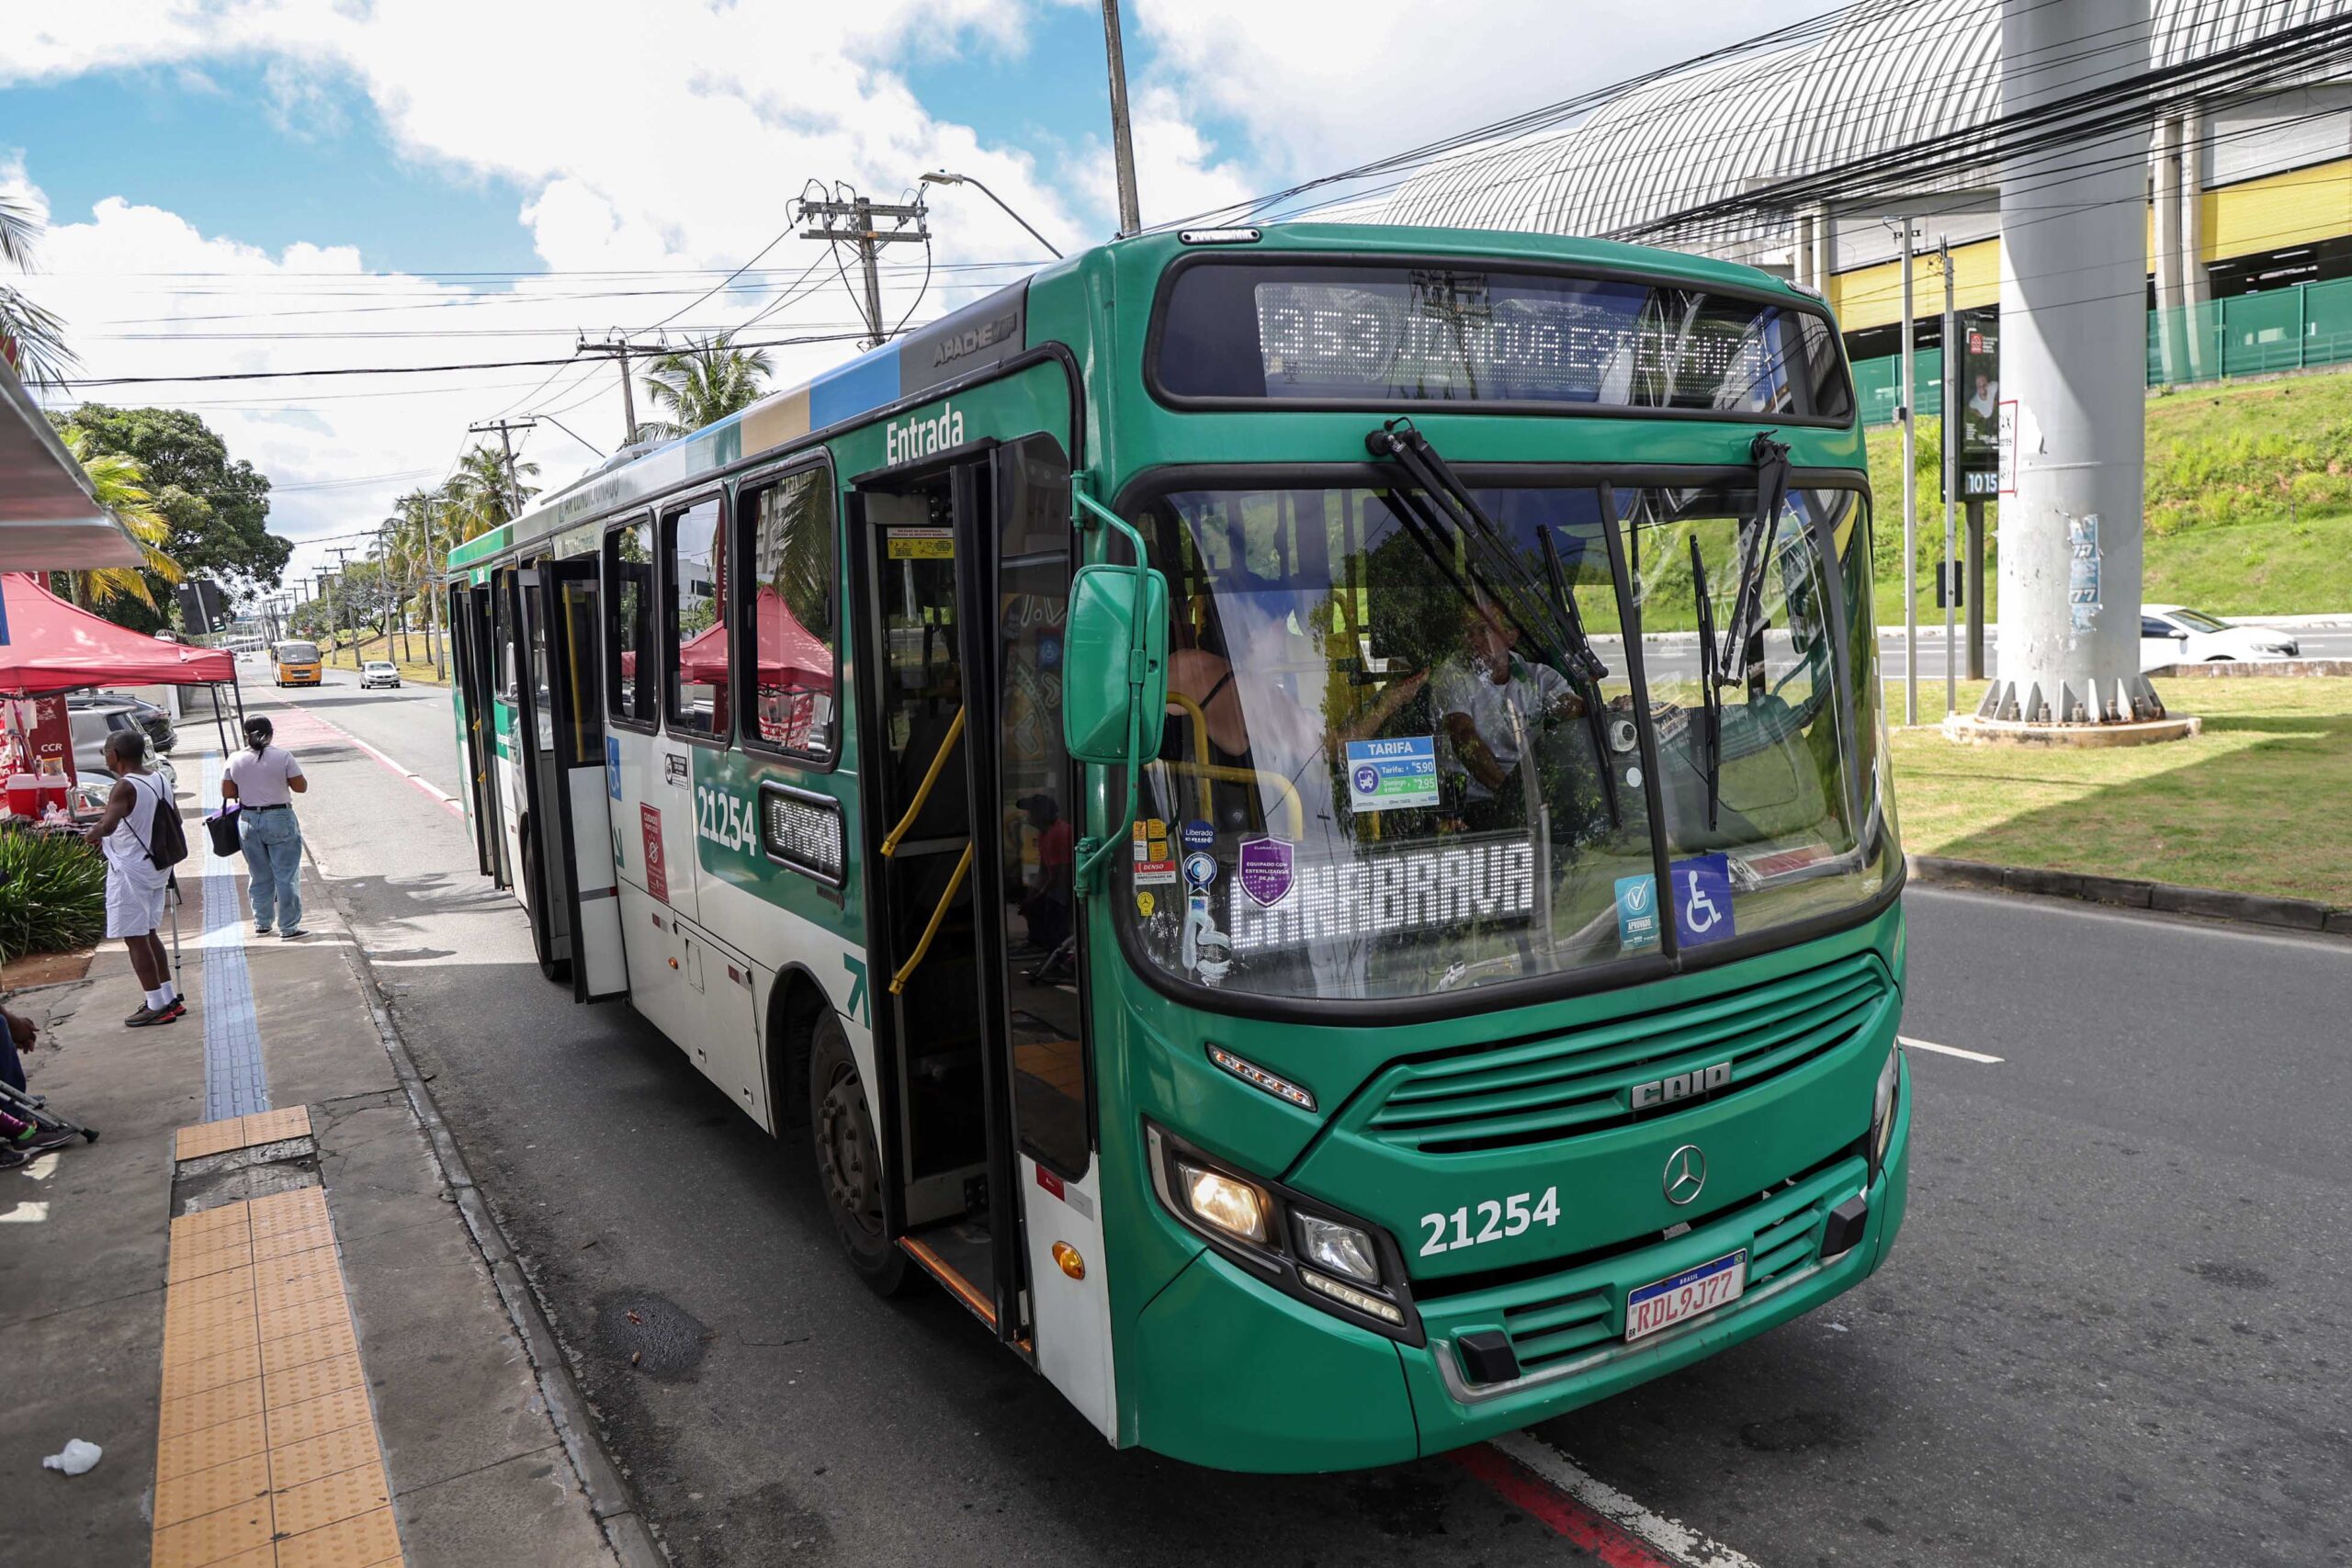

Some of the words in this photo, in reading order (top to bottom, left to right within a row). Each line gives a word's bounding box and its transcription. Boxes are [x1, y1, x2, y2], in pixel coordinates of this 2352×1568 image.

[888, 401, 964, 466] Entrada
[1968, 473, 1982, 493] 10
[1984, 472, 1998, 494] 15
[2072, 589, 2096, 602] 77
[40, 743, 62, 753] CCR
[1367, 741, 1413, 756] TARIFA
[1381, 765, 1405, 773] Tarifa:
[1416, 761, 1433, 773] 5,90
[1418, 778, 1435, 790] 2,95
[698, 785, 757, 857] 21254
[1185, 829, 1214, 837] Liberado
[1627, 918, 1652, 931] APROVADO
[1632, 1061, 1731, 1110] CAIO
[1419, 1187, 1561, 1258] 21254
[1679, 1273, 1699, 1286] BRASIL
[1636, 1270, 1734, 1334] RDL9J77
[1628, 1327, 1637, 1339] BR
